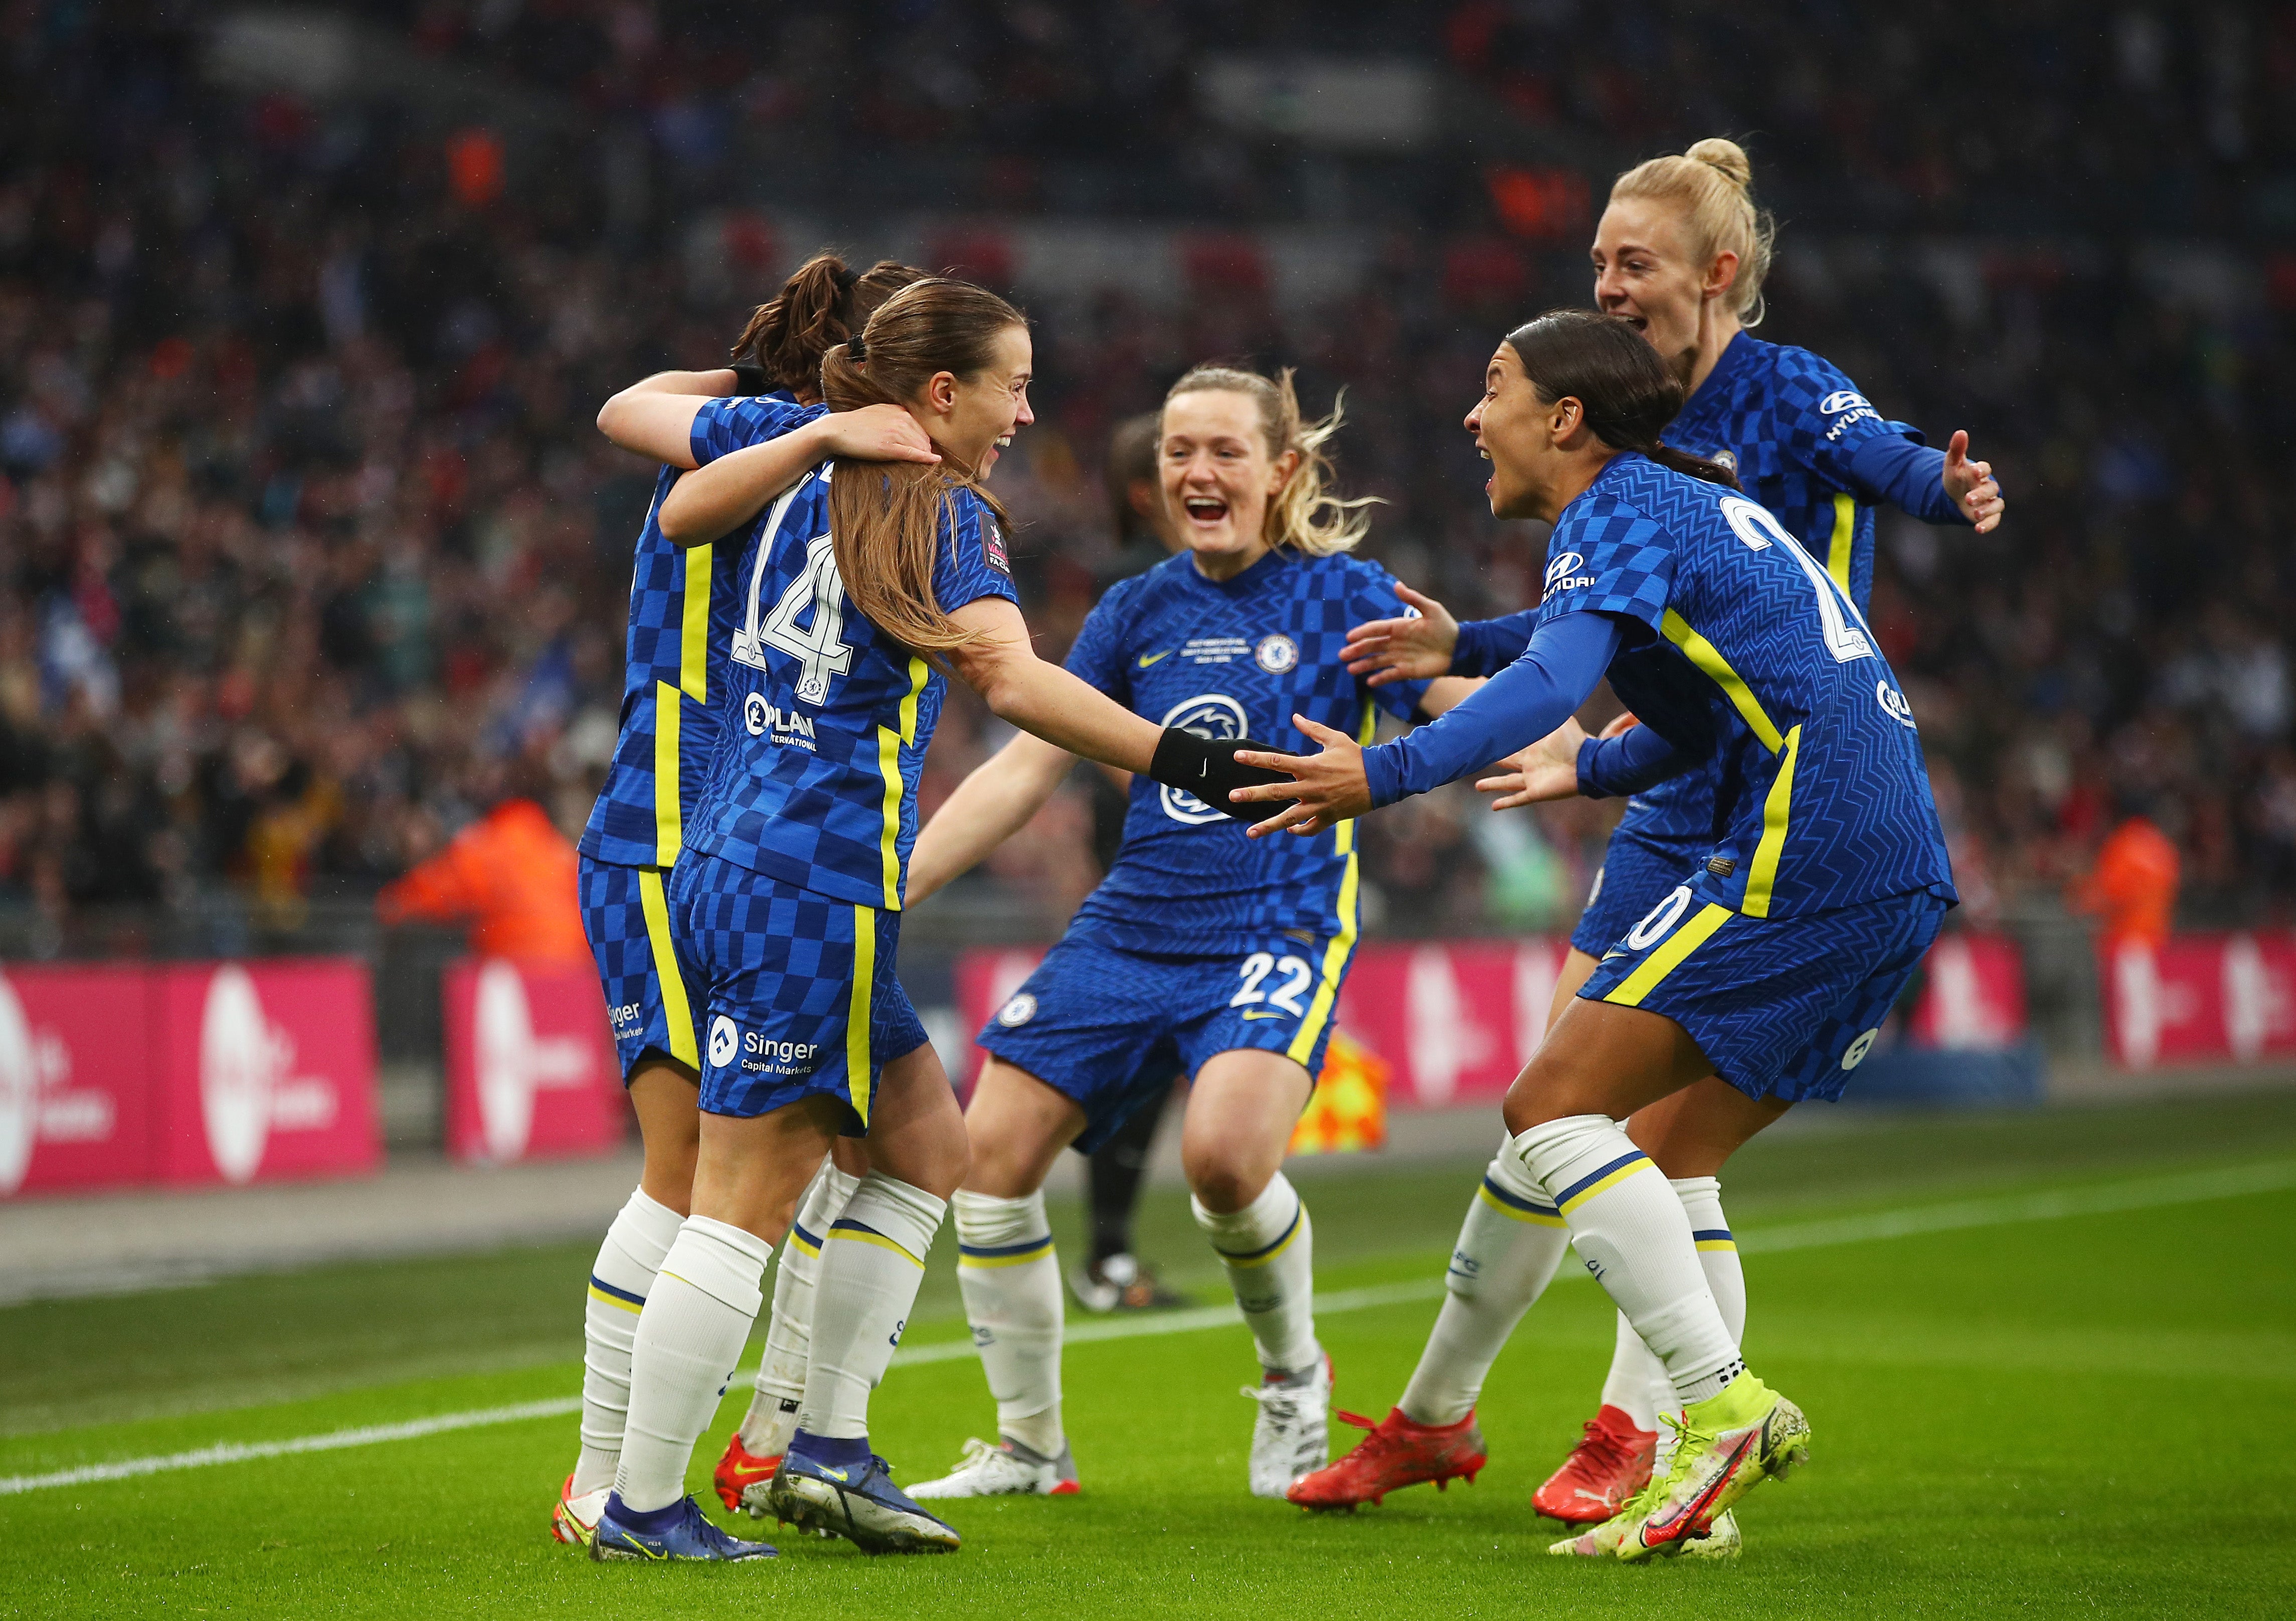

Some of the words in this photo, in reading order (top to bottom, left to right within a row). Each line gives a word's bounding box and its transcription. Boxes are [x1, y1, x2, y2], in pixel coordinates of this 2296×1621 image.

[730, 470, 853, 707] 14
[1719, 496, 1884, 664] 2
[770, 732, 816, 752] TERNATIONAL
[1229, 951, 1312, 1018] 22
[741, 1059, 774, 1073] Capital
[776, 1065, 811, 1075] Markets
[744, 1032, 818, 1063] Singer
